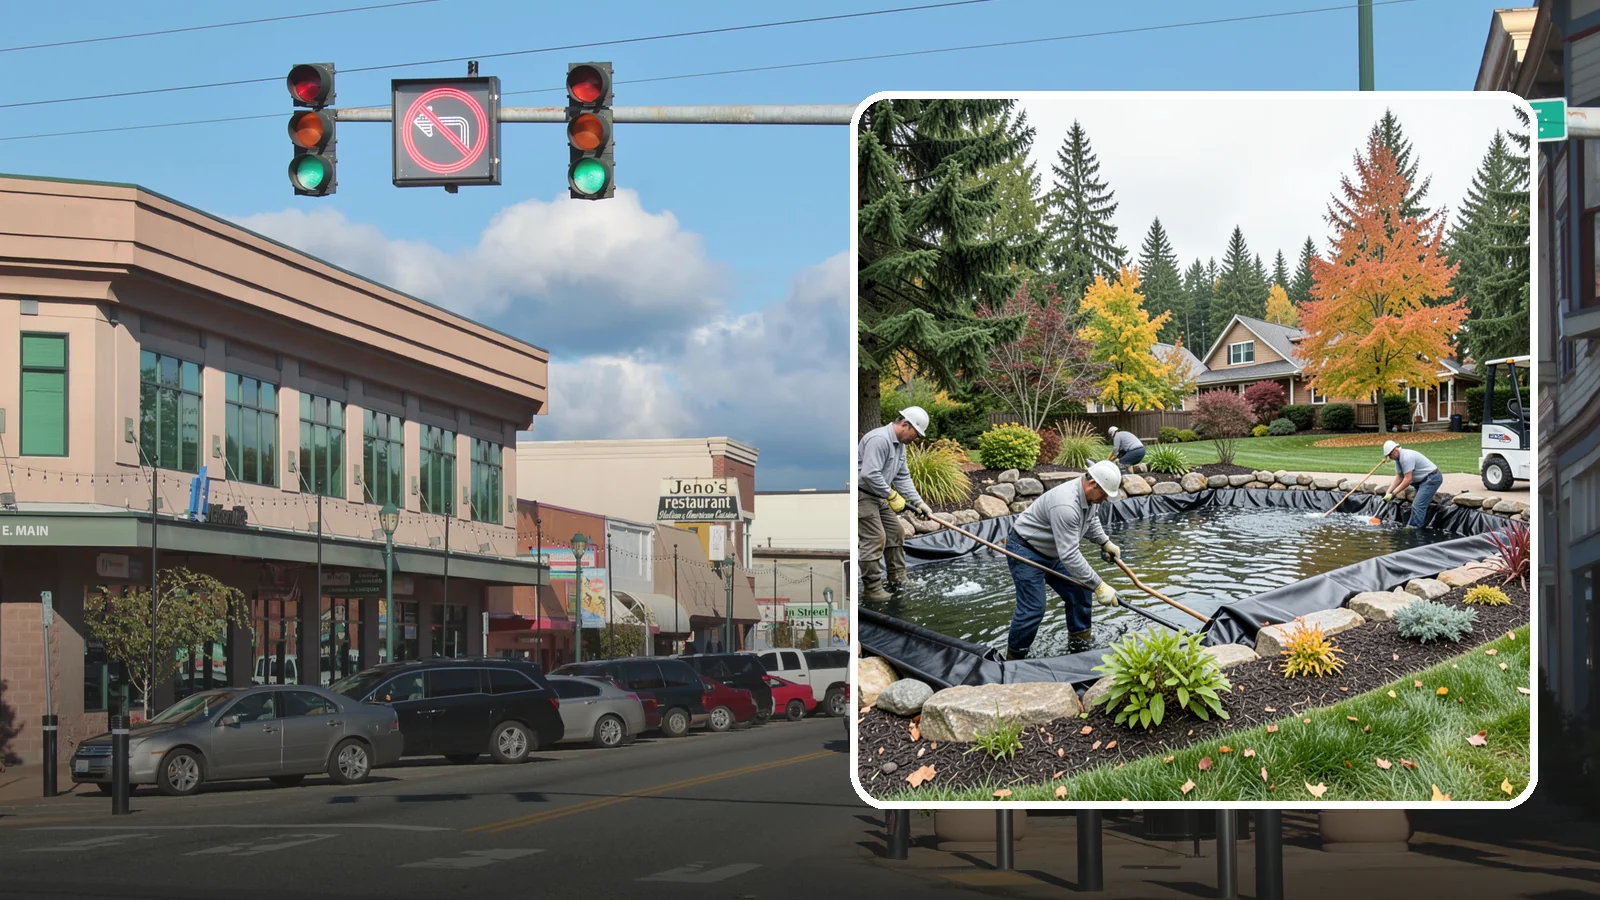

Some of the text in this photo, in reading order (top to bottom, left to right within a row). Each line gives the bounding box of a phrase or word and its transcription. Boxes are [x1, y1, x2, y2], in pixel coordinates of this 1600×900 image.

[670, 480, 727, 494] Jeno's
[665, 496, 731, 509] restaurant
[659, 510, 682, 519] Italian
[686, 509, 714, 519] American
[715, 509, 737, 519] Cuisine
[2, 525, 49, 536] E. MAIN
[797, 608, 828, 617] Street
